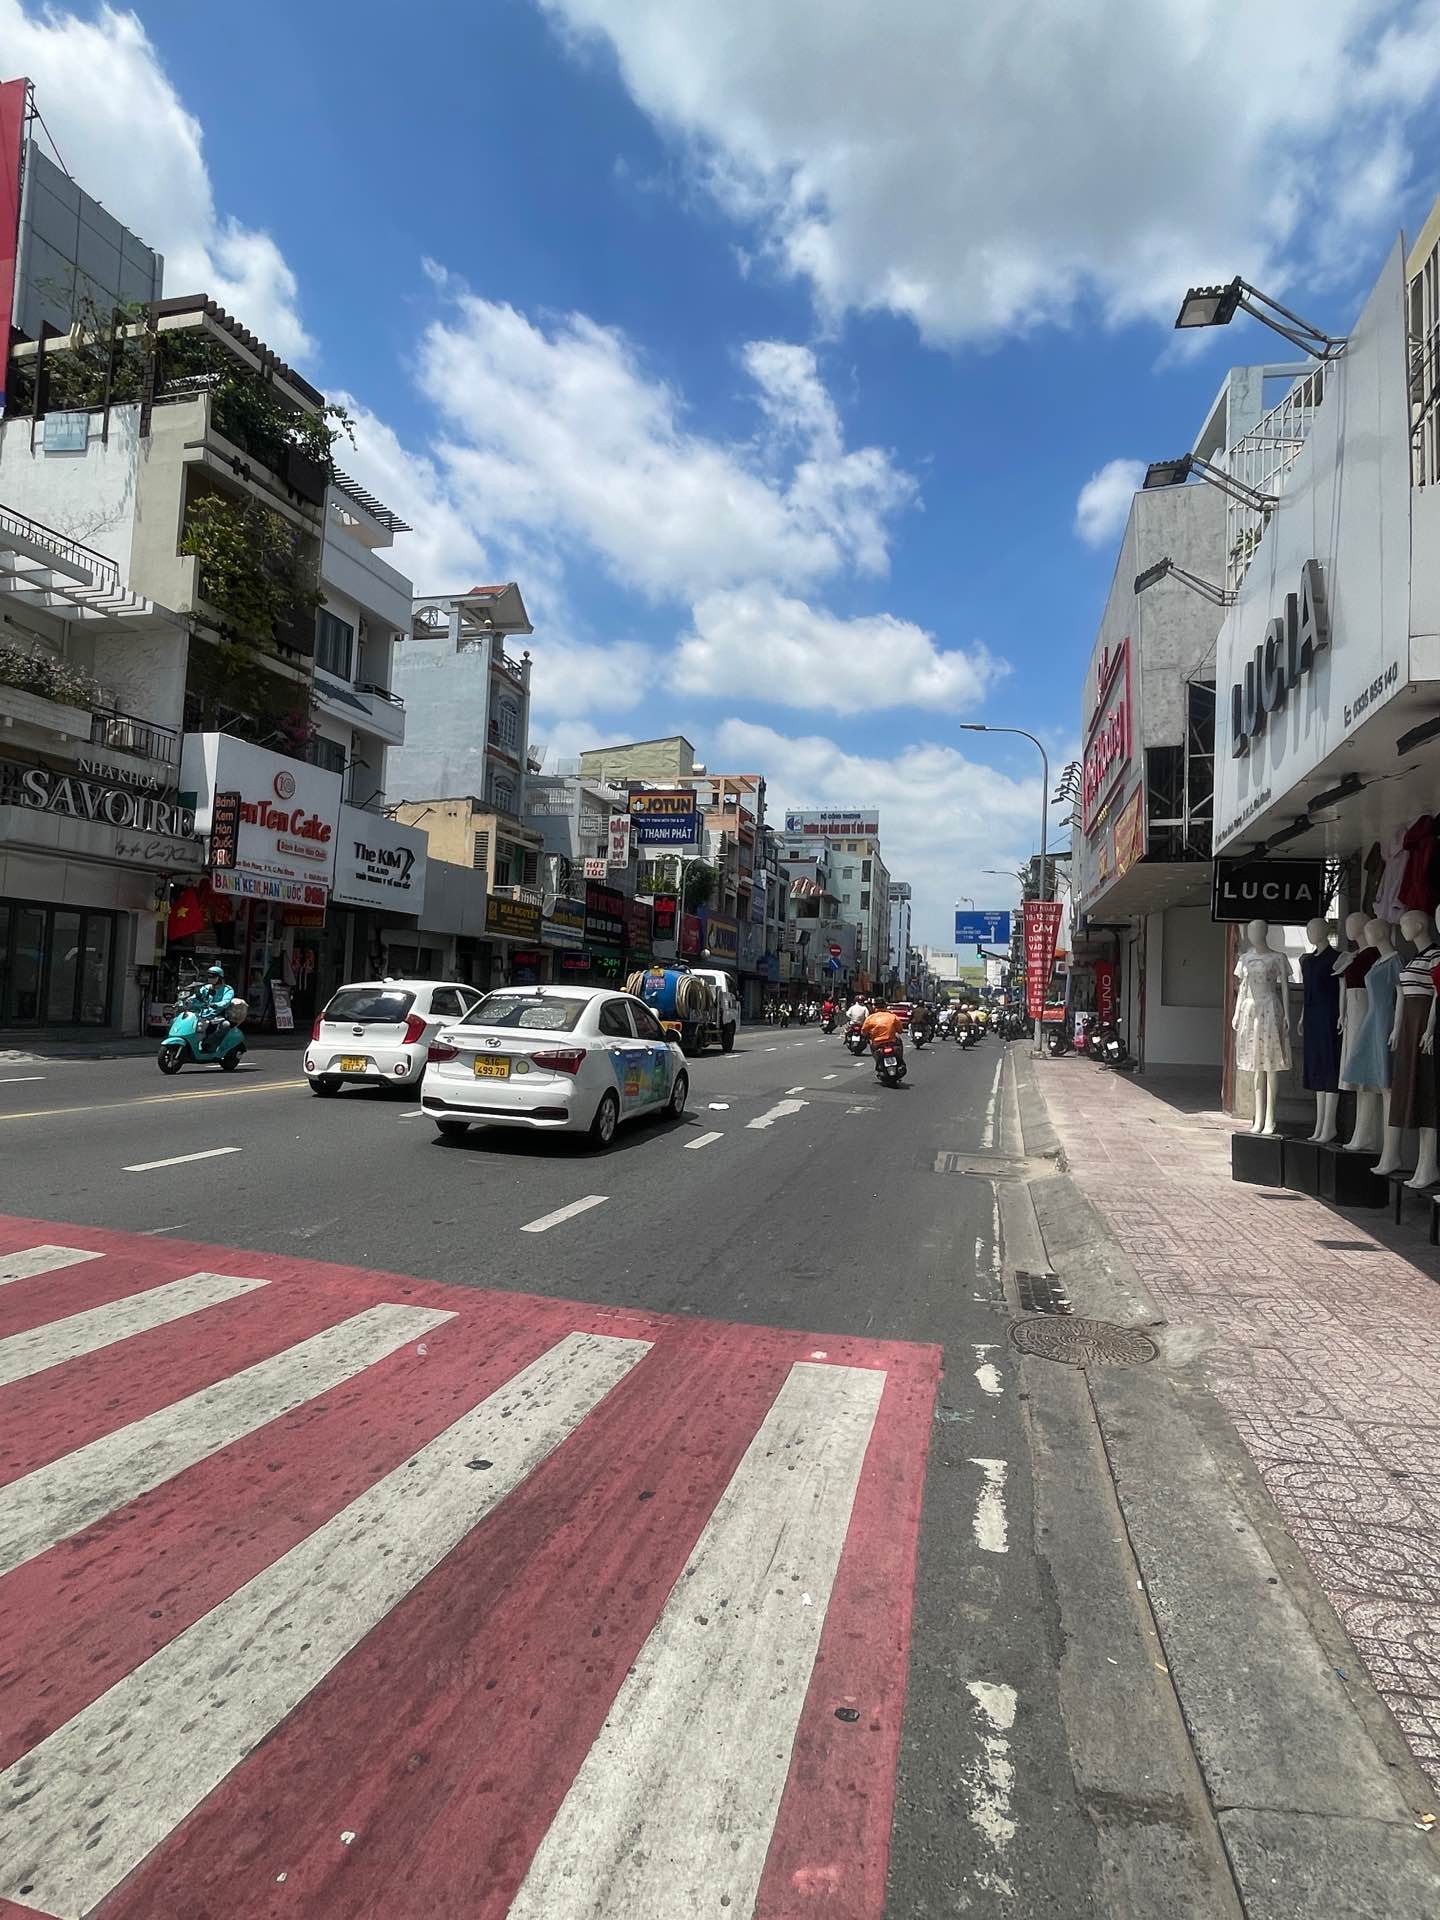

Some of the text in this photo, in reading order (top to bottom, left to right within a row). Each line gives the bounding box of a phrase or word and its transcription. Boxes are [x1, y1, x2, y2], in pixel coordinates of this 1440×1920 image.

[1232, 559, 1328, 759] LUCIA
[77, 758, 158, 791] NHA KHOA
[20, 769, 200, 843] SAVOIRE
[215, 796, 236, 808] Bánh
[646, 797, 692, 812] JOTUN
[215, 809, 234, 821] Kem
[215, 822, 232, 835] Hàn
[291, 808, 332, 842] Cake
[671, 826, 692, 839] PHÁT
[212, 835, 233, 848] Quốc
[353, 841, 376, 862] The
[1223, 881, 1313, 901] LUCIA
